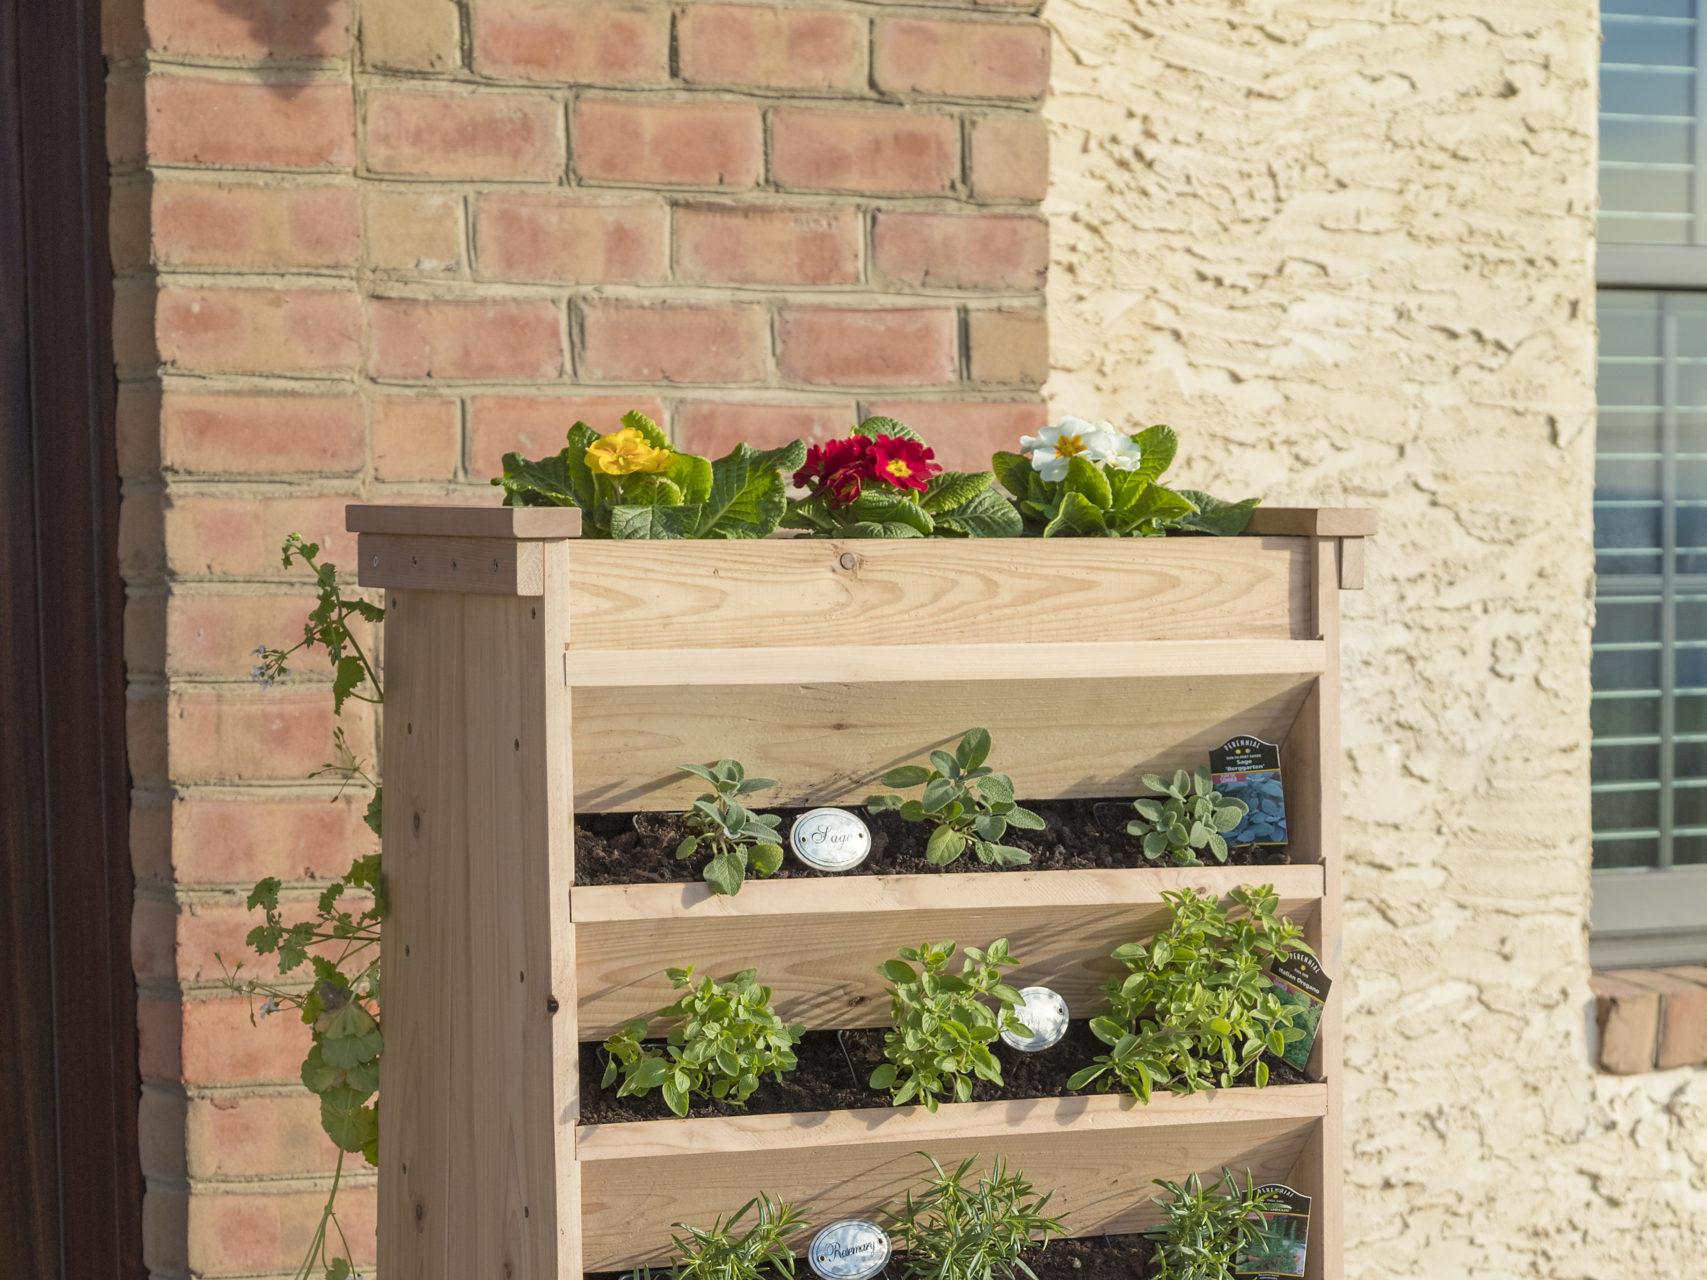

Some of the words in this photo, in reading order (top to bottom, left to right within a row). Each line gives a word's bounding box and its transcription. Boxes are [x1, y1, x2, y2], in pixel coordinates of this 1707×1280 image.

[1223, 739, 1260, 751] PERENNIAL
[1289, 952, 1320, 974] PERENNIAL
[1278, 967, 1297, 981] Italian
[1296, 977, 1320, 994] Oregano
